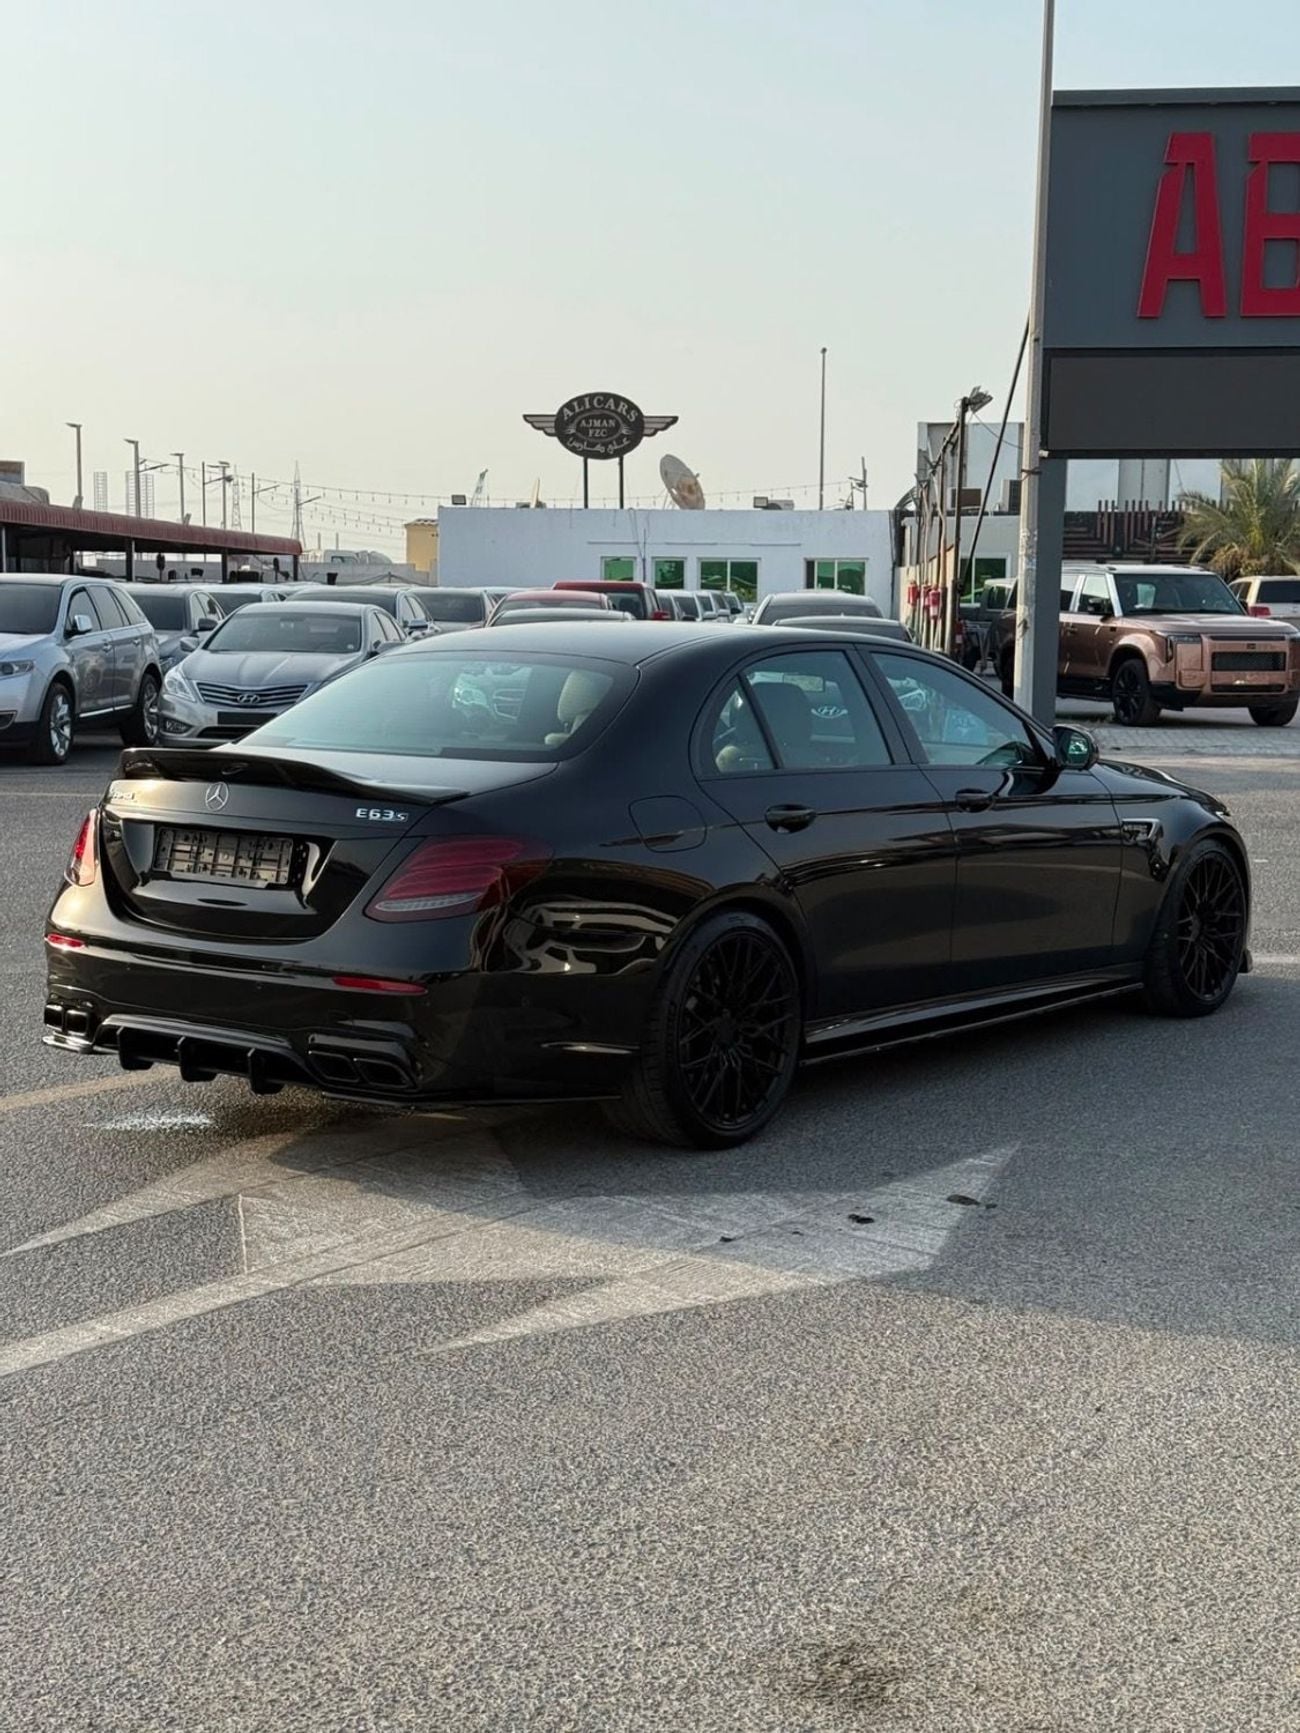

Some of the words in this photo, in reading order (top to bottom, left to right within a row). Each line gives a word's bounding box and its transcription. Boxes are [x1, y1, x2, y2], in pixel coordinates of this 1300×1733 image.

[1137, 131, 1300, 318] AB
[563, 396, 638, 422] ALICARS
[580, 419, 616, 428] AJMAN
[588, 429, 608, 437] FZC
